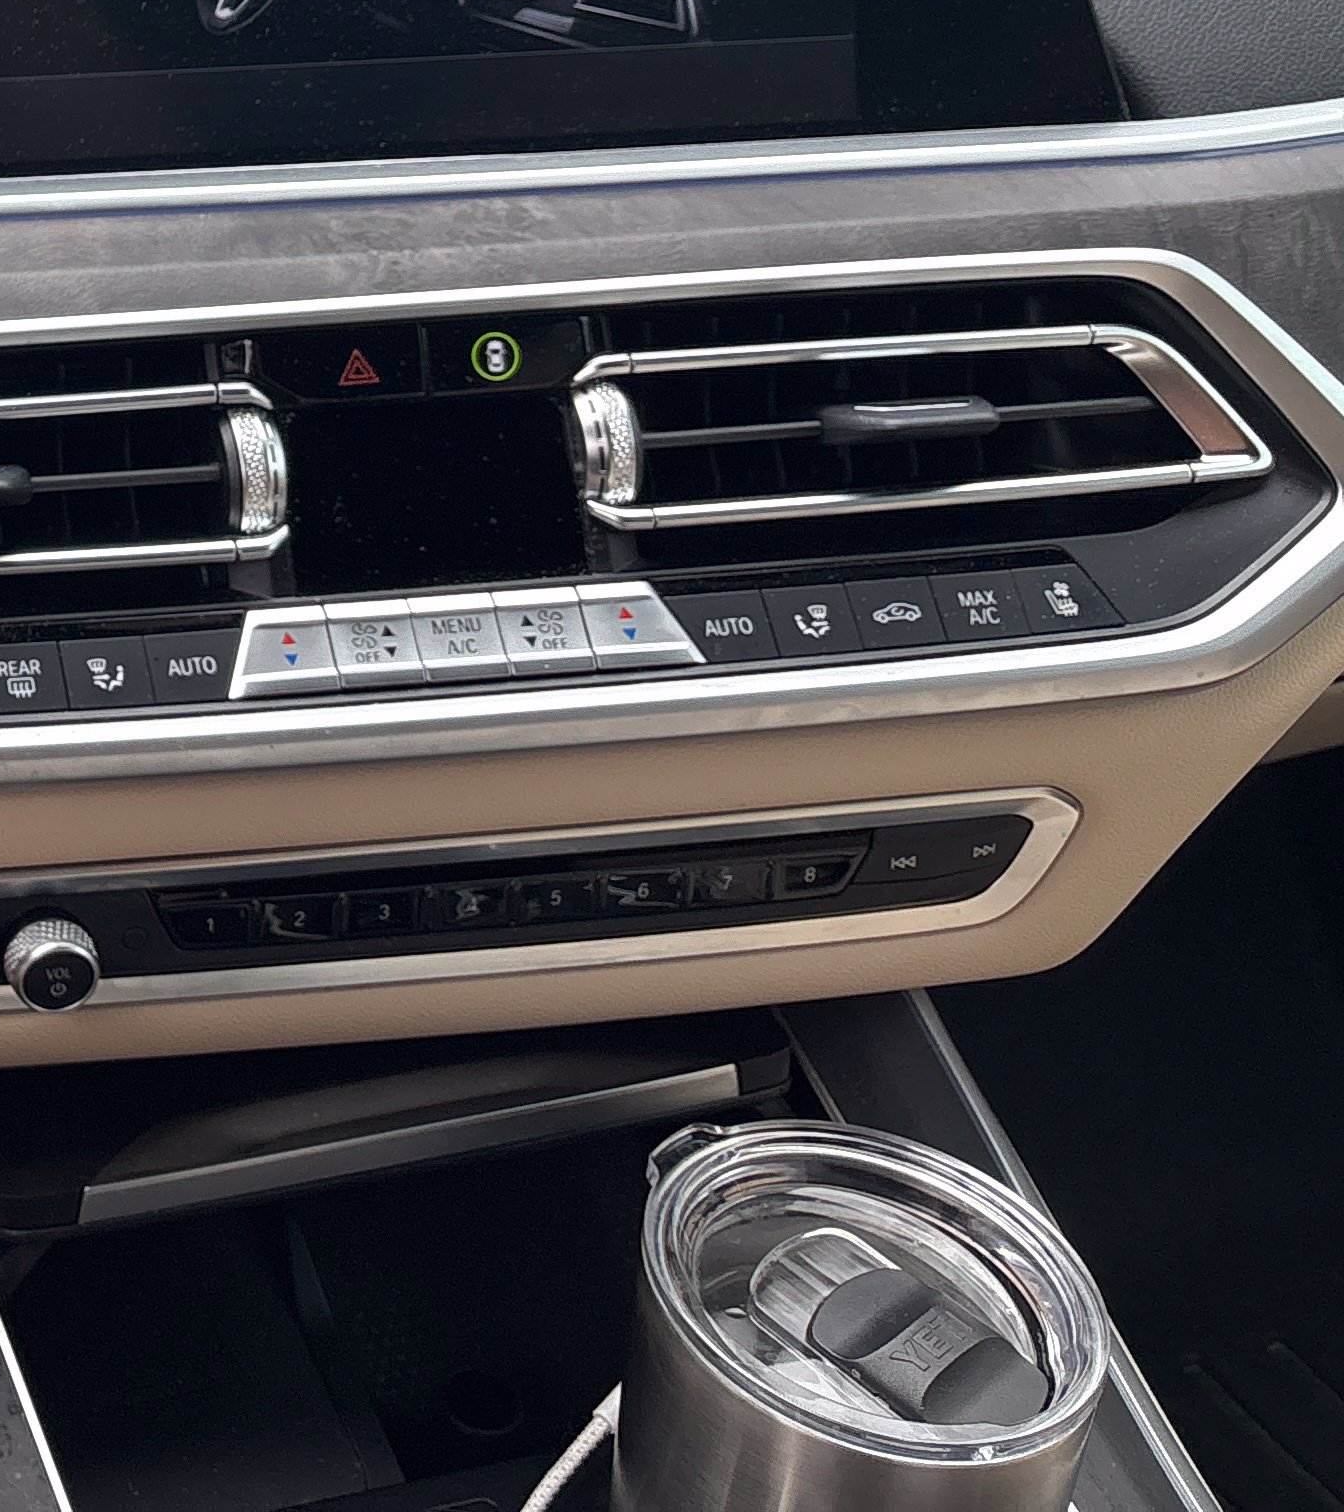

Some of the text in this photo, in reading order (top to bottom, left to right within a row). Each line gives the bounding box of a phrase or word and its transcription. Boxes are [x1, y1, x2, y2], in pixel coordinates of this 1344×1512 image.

[957, 590, 999, 611] MAX
[968, 607, 1002, 626] A/C
[430, 617, 482, 635] MENU
[704, 617, 754, 638] AUTO
[447, 638, 479, 655] A/C
[542, 636, 569, 650] OFF
[355, 650, 381, 663] OFF
[168, 655, 218, 679] AUTO
[803, 865, 818, 882] 8
[549, 889, 562, 906] 5
[637, 881, 650, 899] 6
[293, 910, 307, 928] 2
[378, 904, 391, 921] 3
[45, 965, 72, 982] VOL
[888, 1308, 976, 1376] YETI
